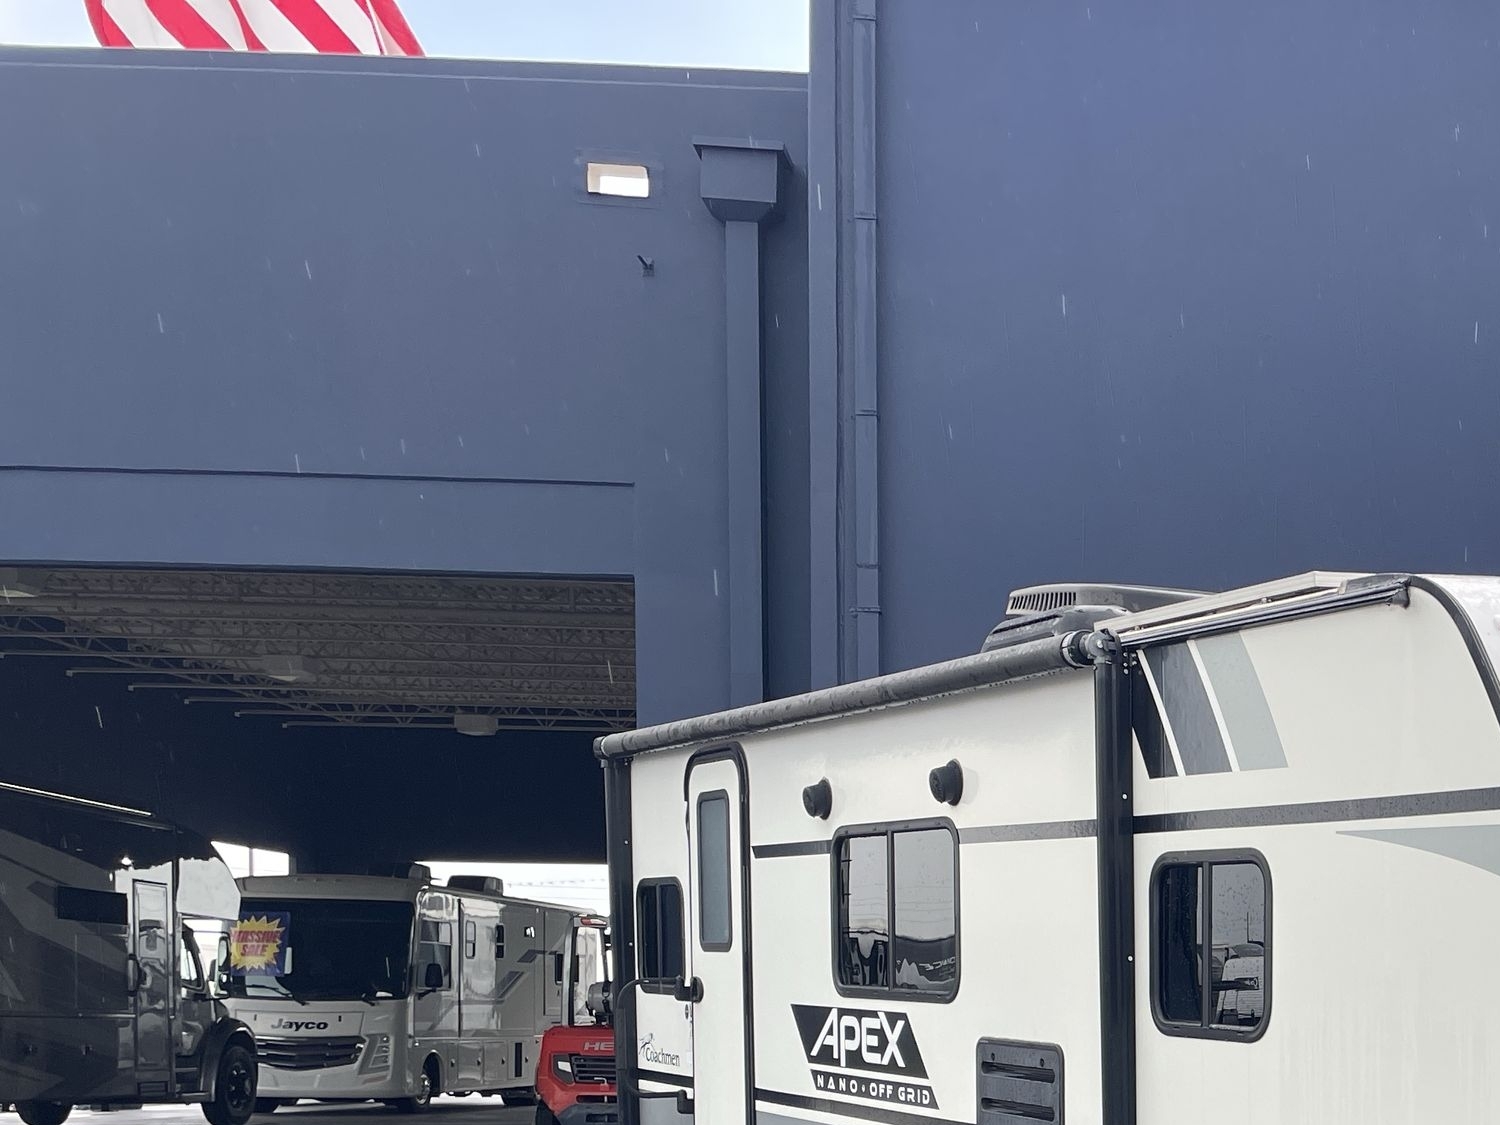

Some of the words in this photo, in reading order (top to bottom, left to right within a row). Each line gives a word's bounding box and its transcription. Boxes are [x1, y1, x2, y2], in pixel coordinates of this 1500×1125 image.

[240, 944, 269, 957] SALE
[271, 1018, 329, 1032] Jayco
[810, 1007, 906, 1068] APEX
[645, 1047, 681, 1066] Coachmen
[816, 1074, 858, 1094] NANO
[869, 1082, 894, 1099] OFF
[897, 1086, 930, 1105] GRID
